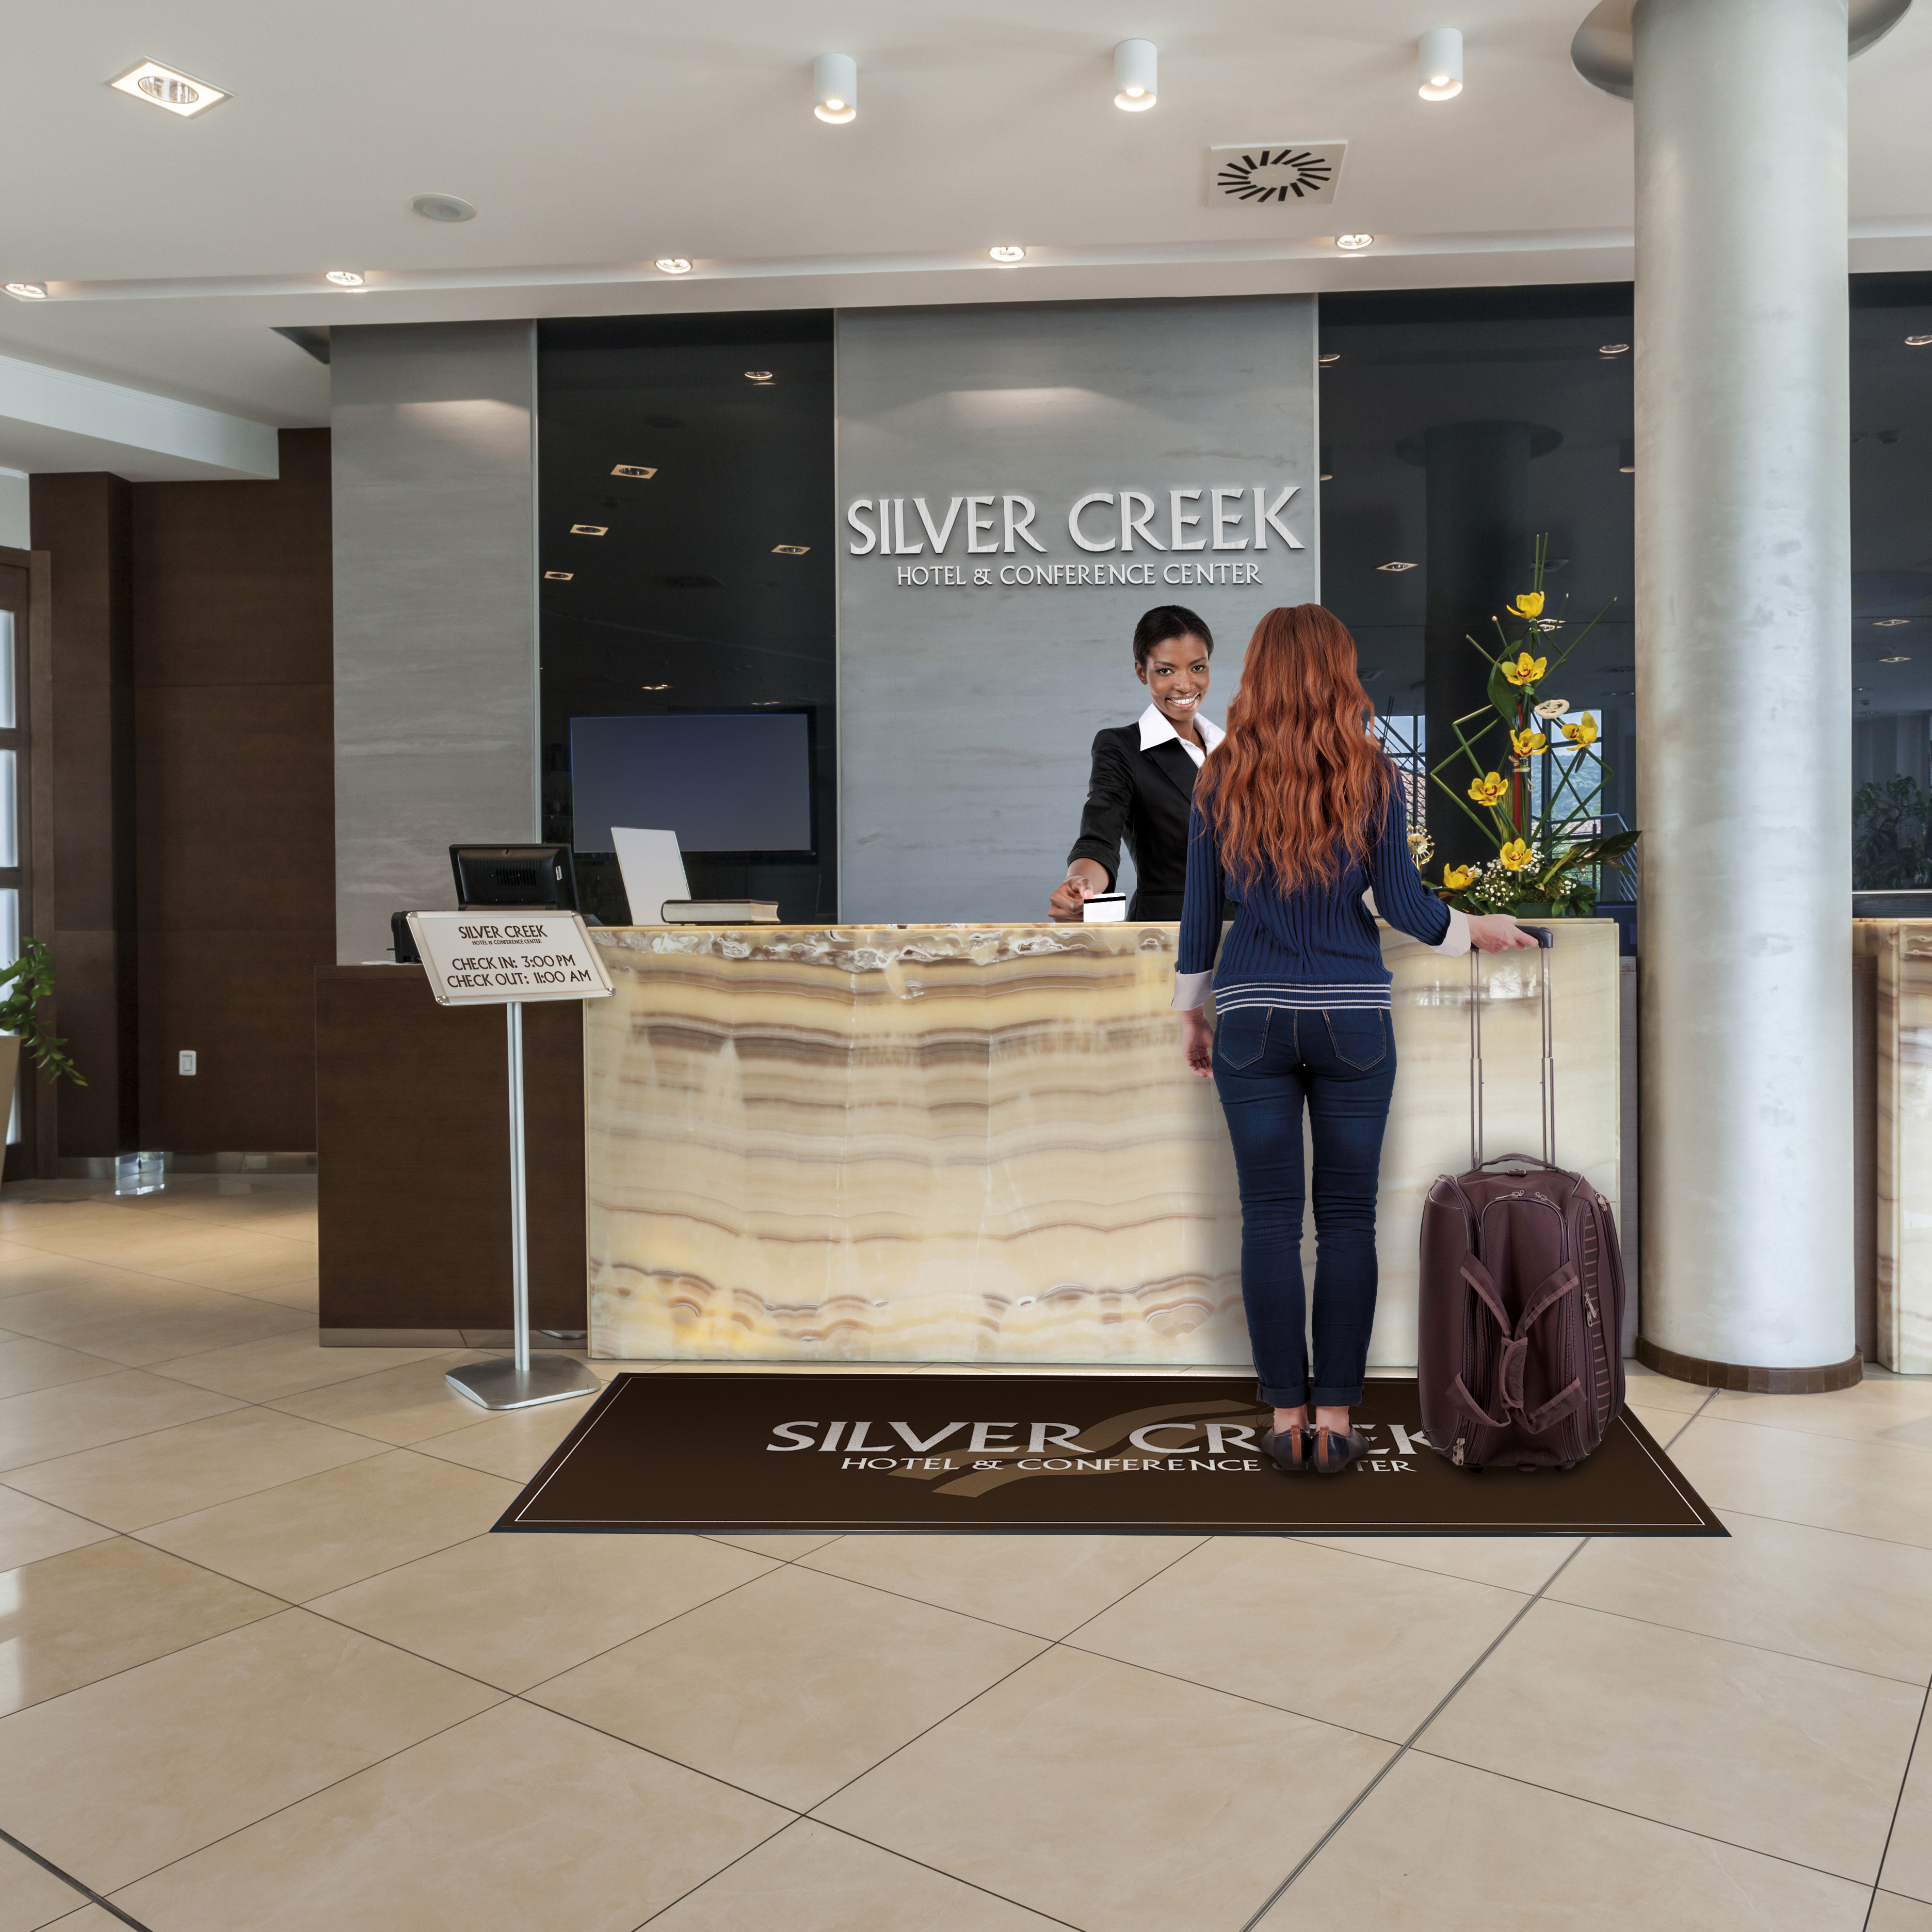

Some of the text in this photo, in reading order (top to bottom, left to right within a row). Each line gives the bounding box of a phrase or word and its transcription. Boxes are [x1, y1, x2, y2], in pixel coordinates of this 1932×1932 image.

[847, 486, 1306, 555] SILVER CREEK
[897, 562, 1263, 586] HOTEL & CONFERENCE CENTER
[458, 925, 549, 939] SILVER CREEK
[452, 954, 576, 971] CHECK IN: 3:00 PM
[447, 969, 592, 988] CHECK OUT: 11:00 AM
[766, 1421, 1437, 1455] SILVER CRK
[841, 1457, 960, 1470] HOTEL
[972, 1459, 1005, 1471] &
[1017, 1458, 1262, 1472] CONFERENCE
